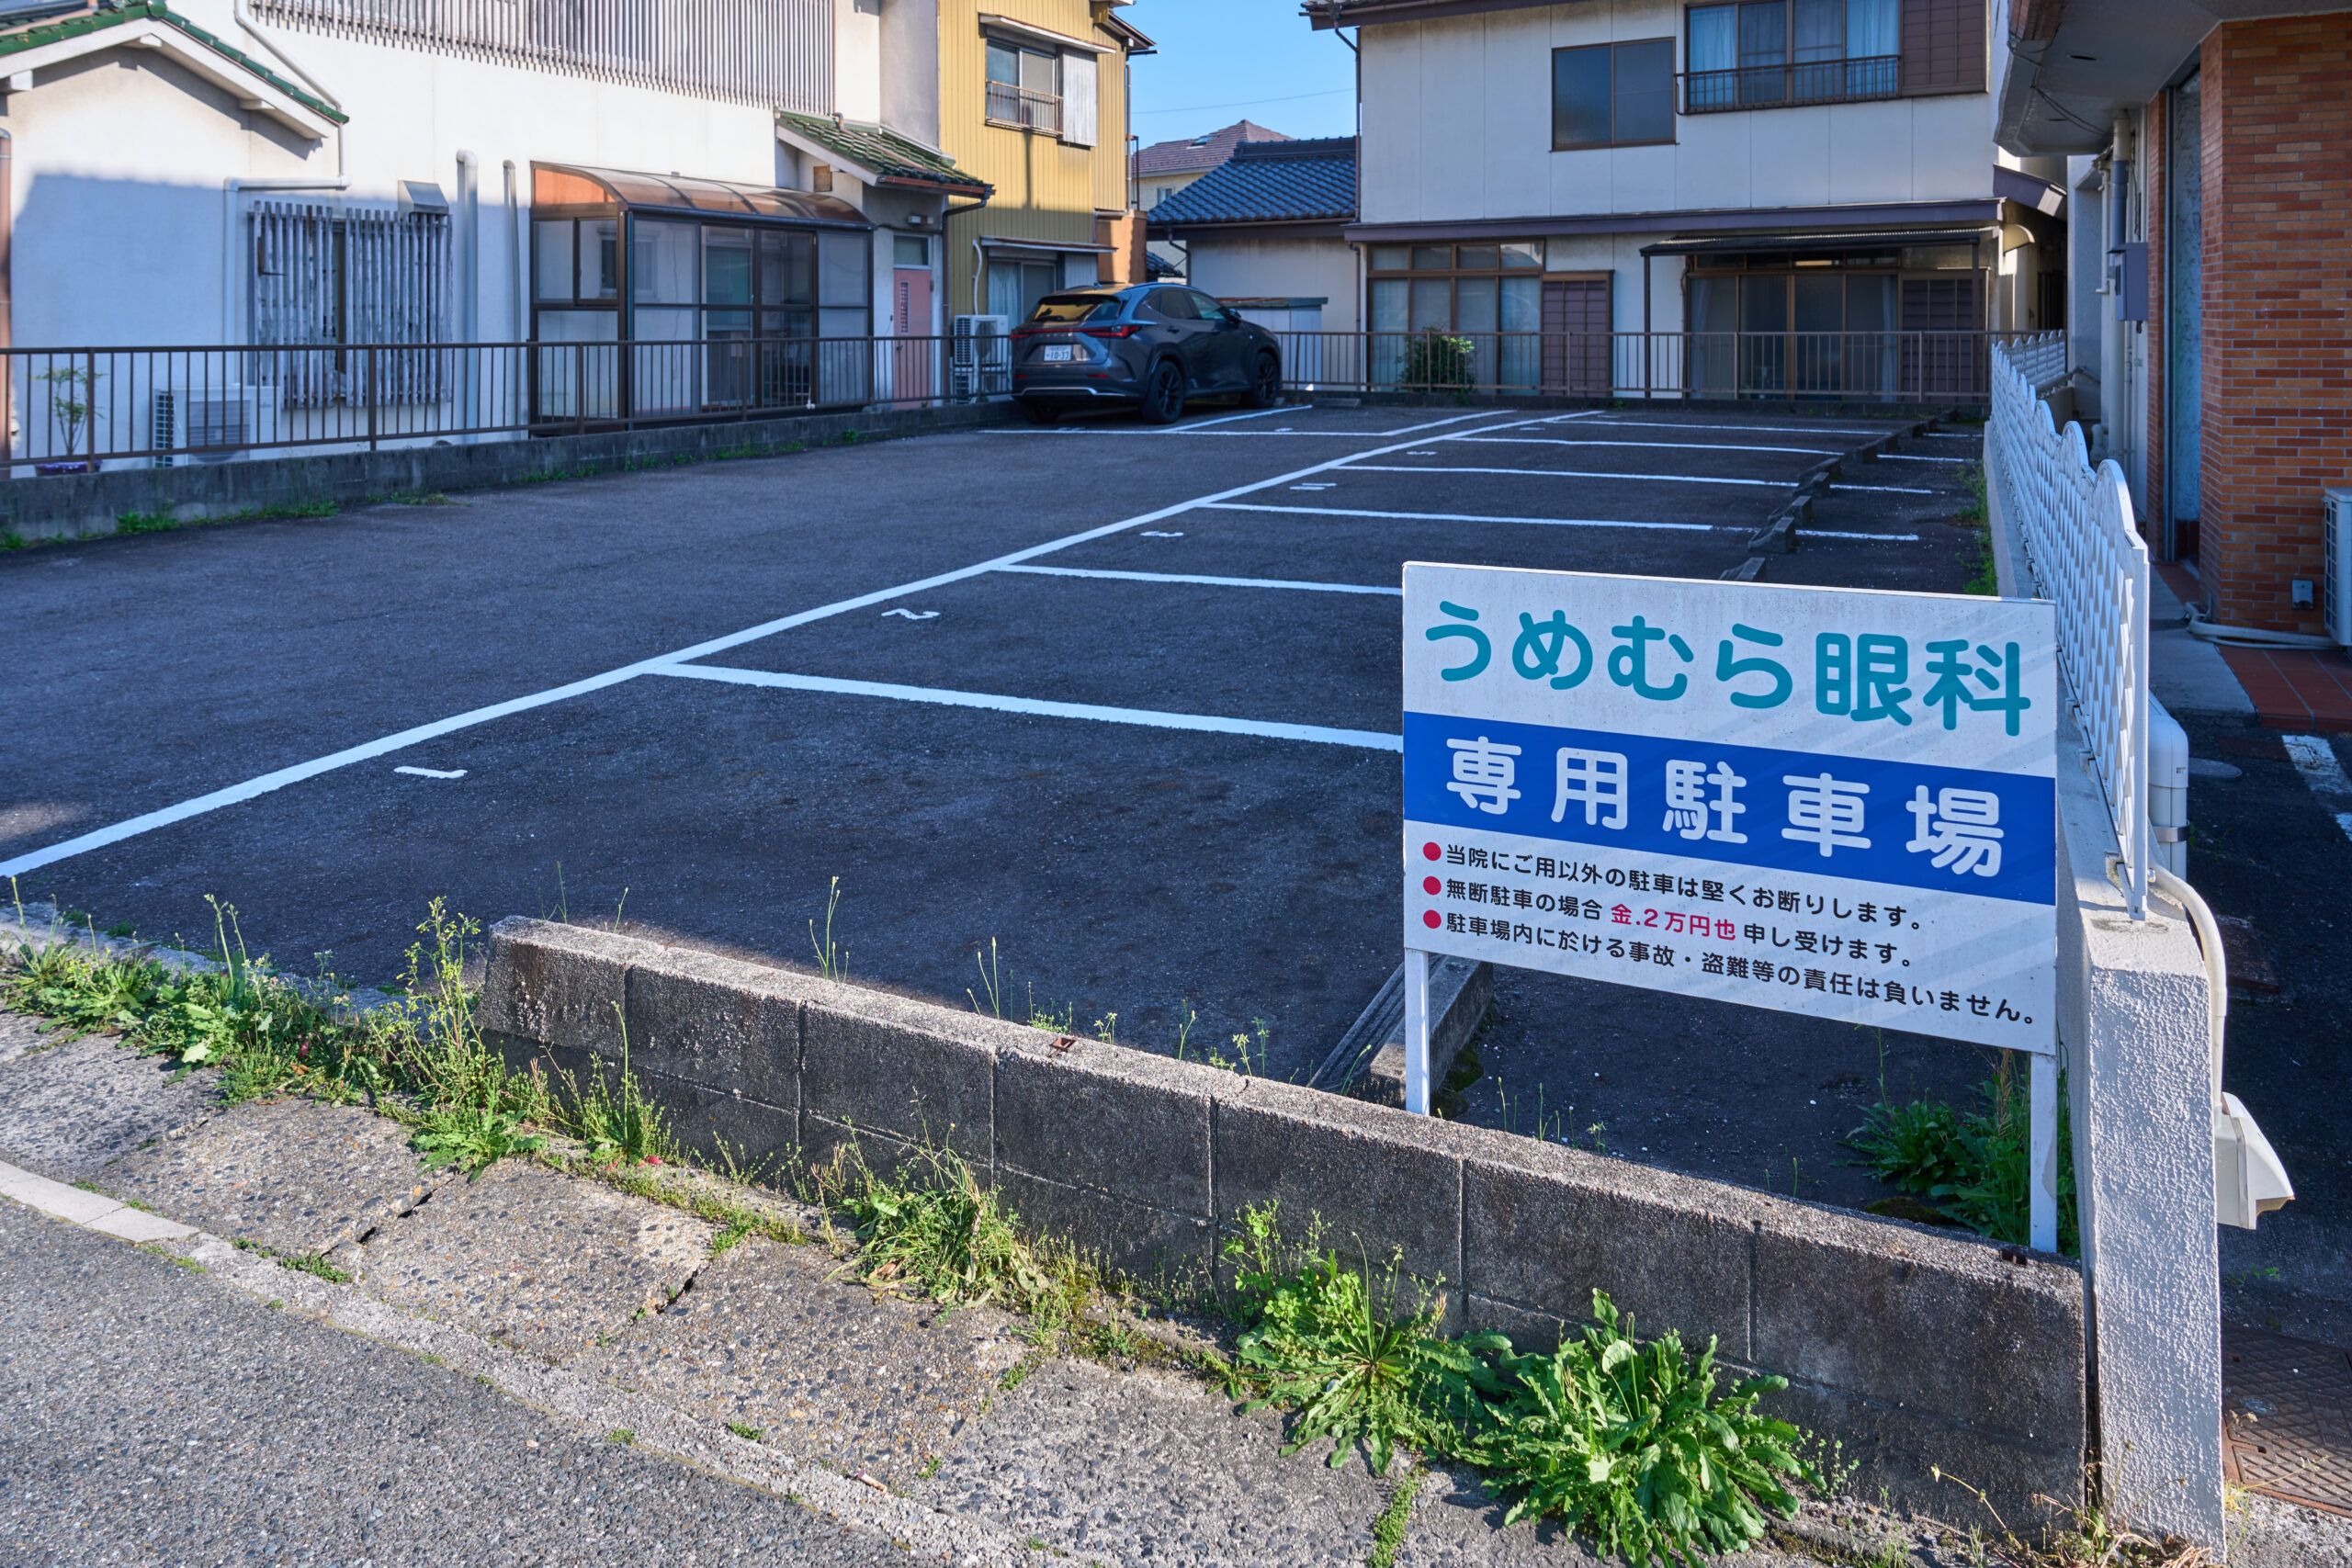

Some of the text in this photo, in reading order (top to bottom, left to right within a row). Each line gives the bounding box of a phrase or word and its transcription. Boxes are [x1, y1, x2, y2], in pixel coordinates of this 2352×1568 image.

[1425, 600, 2031, 737] うめむら眼科
[1446, 736, 2005, 878] 専用駐車場
[1446, 843, 1920, 931] 当院にご用以外の駐車は堅くお断りします。
[1446, 878, 1603, 920] 無断駐車の場合
[1744, 922, 1910, 967] 申し受けます。
[1446, 912, 2033, 1025] 駐車場内に於ける事故・盗難等の責任は負いません。
